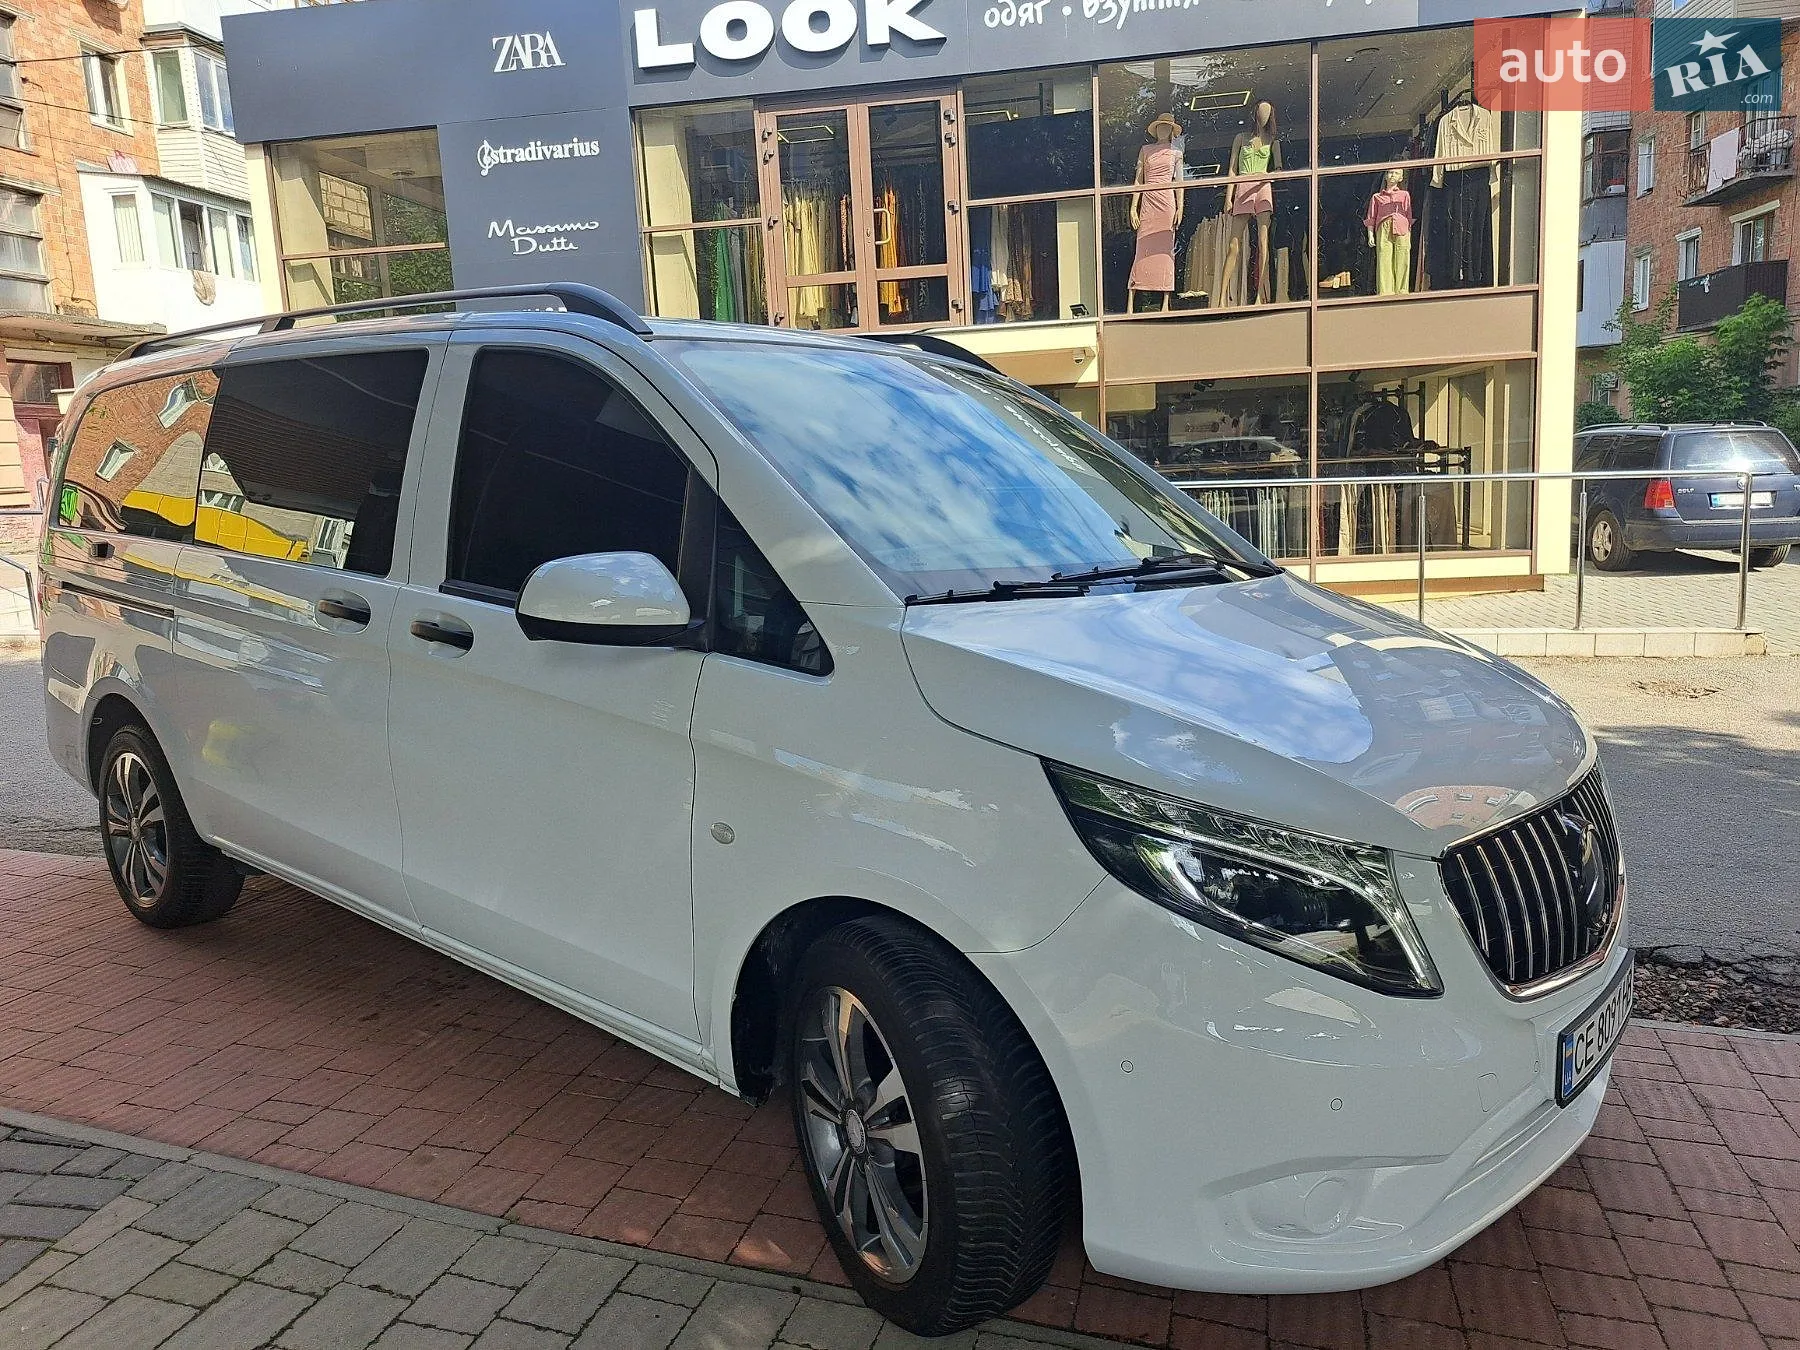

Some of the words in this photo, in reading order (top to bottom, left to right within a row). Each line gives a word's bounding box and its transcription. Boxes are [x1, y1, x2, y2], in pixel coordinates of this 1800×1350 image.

[984, 1, 1049, 28] одяг
[634, 0, 947, 68] LOOK
[492, 31, 567, 73] ZARA
[487, 219, 600, 239] Massimo
[510, 236, 579, 255] Dutti
[1574, 1020, 1595, 1075] CE
